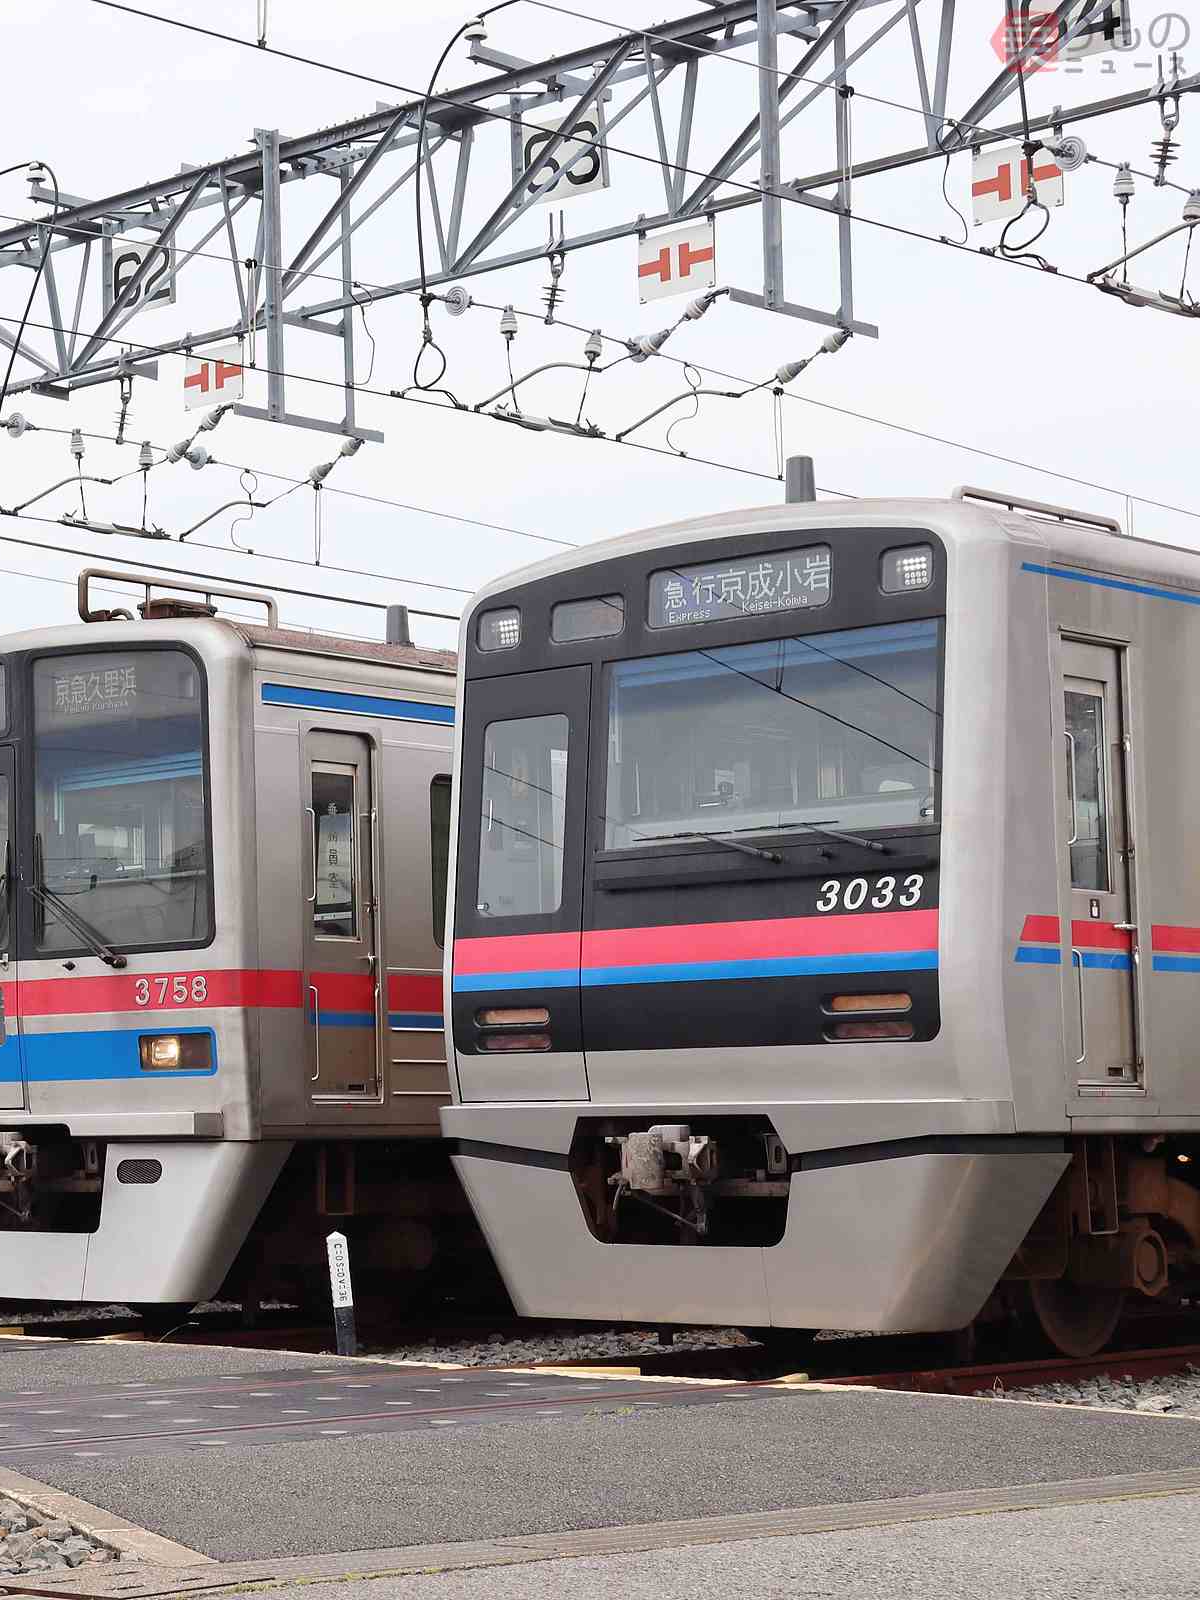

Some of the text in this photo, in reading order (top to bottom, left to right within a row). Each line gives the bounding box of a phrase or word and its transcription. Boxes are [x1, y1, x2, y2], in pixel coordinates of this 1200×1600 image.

[523, 120, 601, 194] 63
[113, 245, 171, 309] 62
[668, 607, 712, 624] Express
[816, 874, 925, 912] 3033
[135, 975, 208, 1006] 3758
